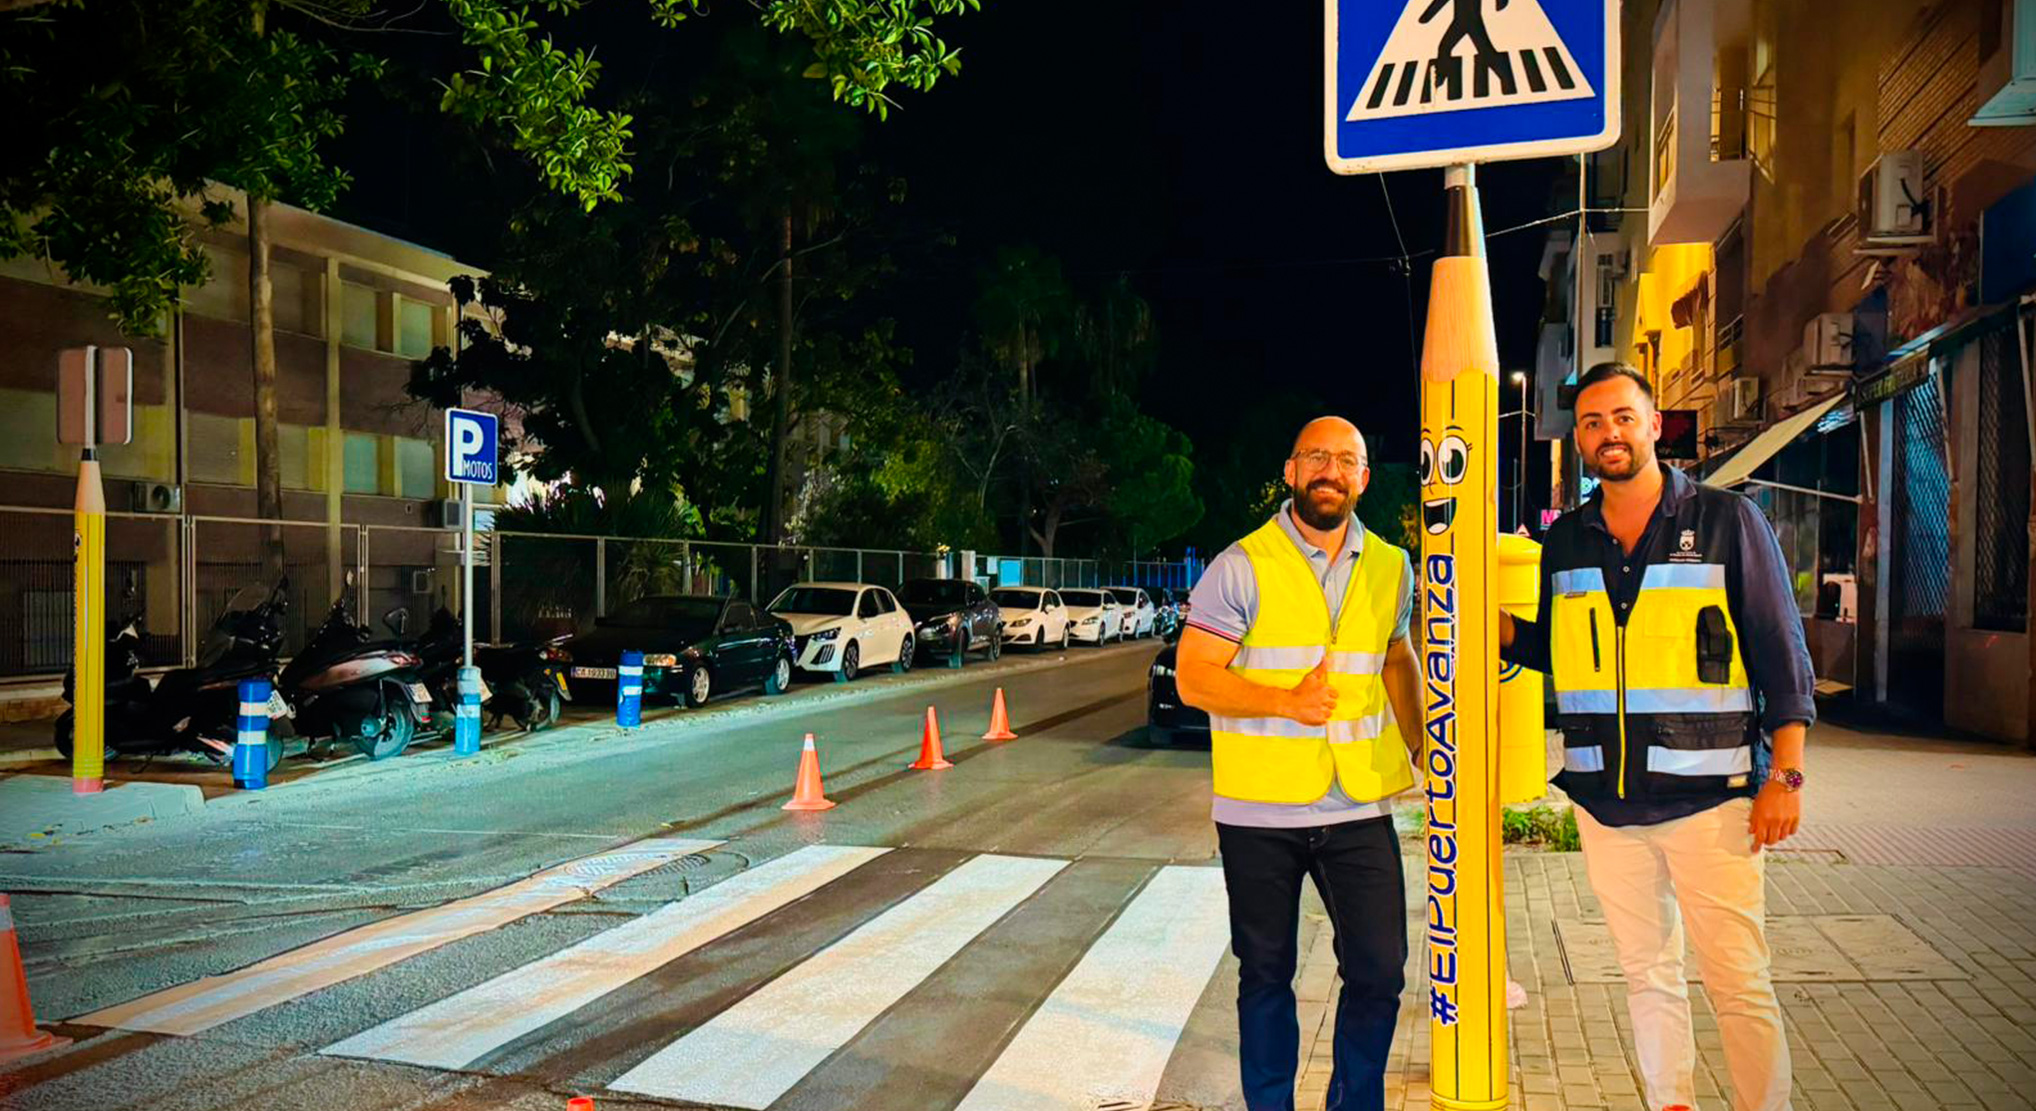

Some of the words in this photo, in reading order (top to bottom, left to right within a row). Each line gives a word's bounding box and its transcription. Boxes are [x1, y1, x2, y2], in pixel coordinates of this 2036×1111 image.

[453, 417, 484, 476] P
[463, 459, 493, 480] MOTOS
[1425, 553, 1458, 1026] #ElPuertoAvanza
